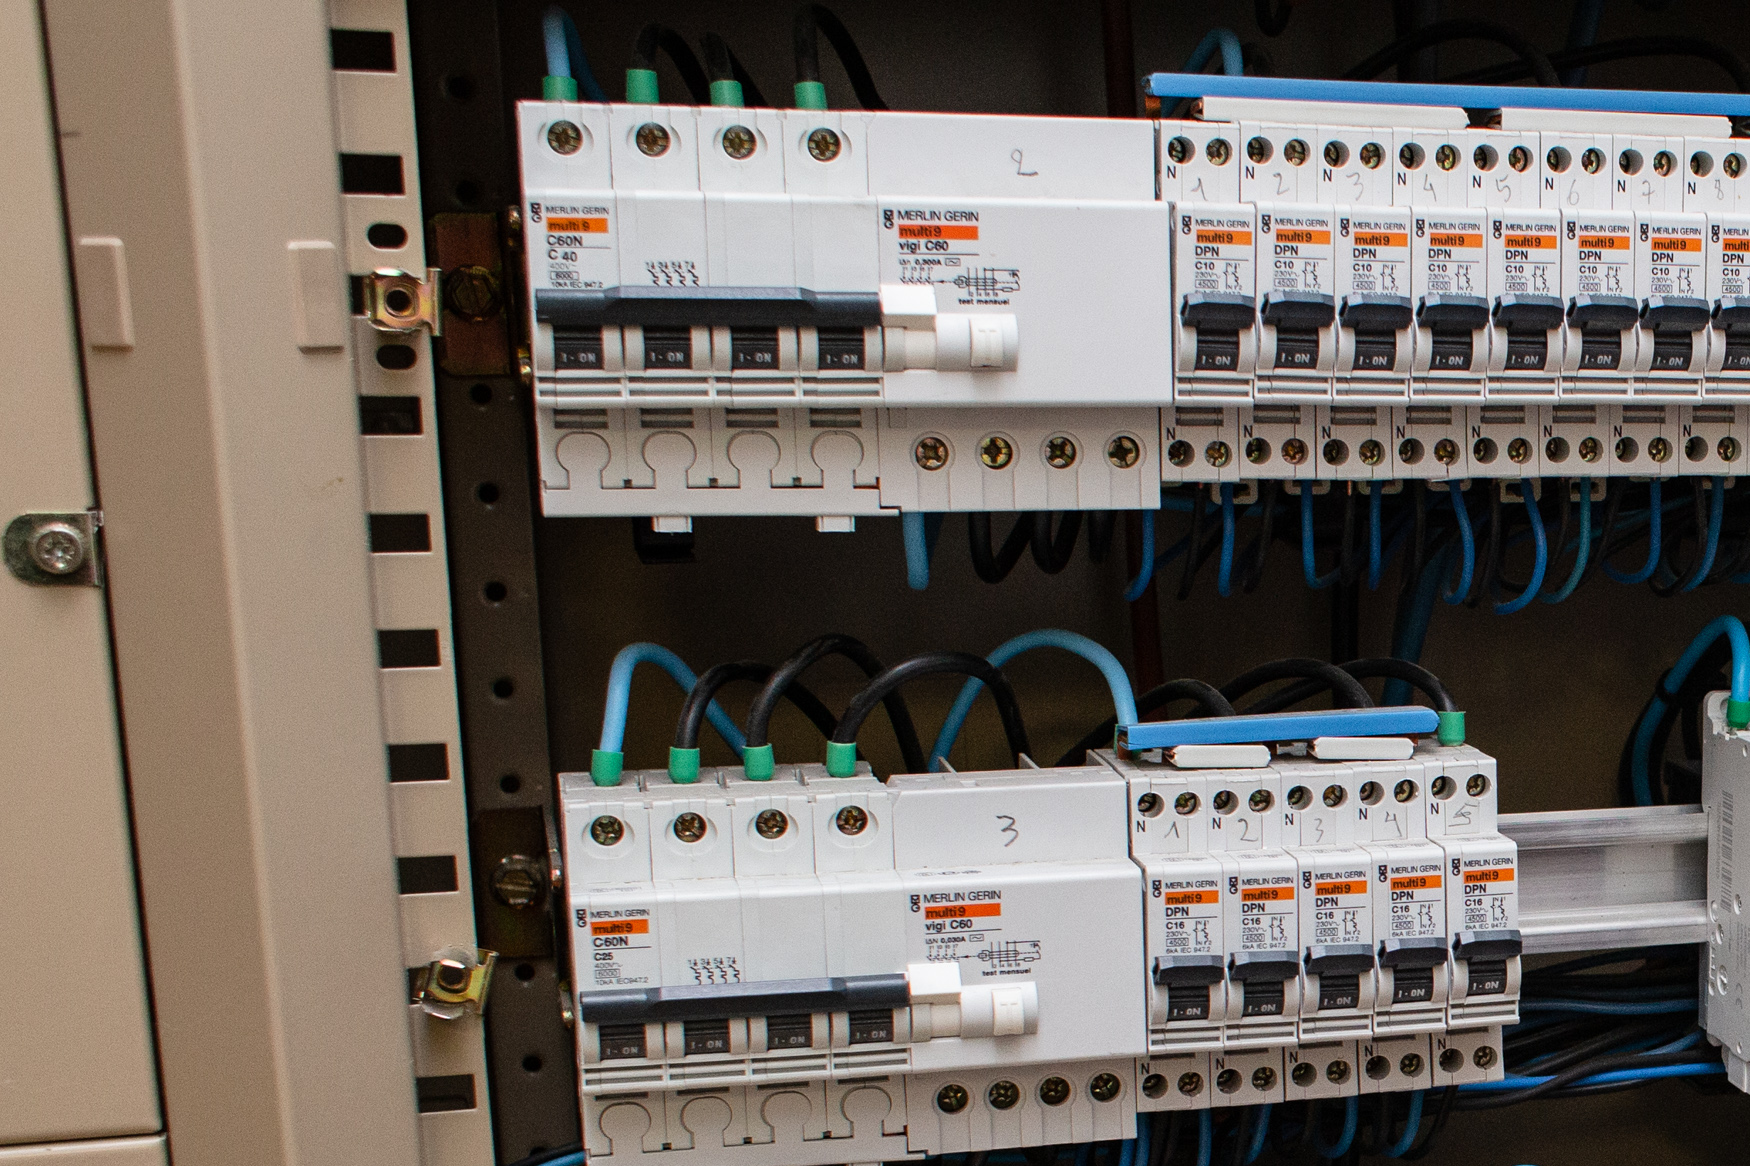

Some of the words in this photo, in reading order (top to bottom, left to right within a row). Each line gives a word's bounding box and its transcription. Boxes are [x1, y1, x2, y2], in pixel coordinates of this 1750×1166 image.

[546, 206, 580, 215] MERLIN
[582, 207, 609, 215] GERIN
[898, 211, 941, 222] MERLIN
[944, 211, 979, 222] GERIN
[1195, 218, 1225, 228] MERLIN
[1226, 219, 1250, 229] GERIN
[547, 235, 583, 247] C60N
[899, 240, 921, 253] vigi
[925, 240, 949, 251] C60
[562, 251, 578, 262] 40
[1195, 245, 1219, 257] DPN
[1352, 248, 1376, 259] DPN
[1195, 261, 1215, 270] C10
[1164, 821, 1180, 838] 1
[1385, 811, 1403, 837] 4
[996, 815, 1019, 847] 3
[1237, 818, 1259, 842] 2
[1314, 818, 1324, 843] 3
[1464, 859, 1491, 868] MERLIN
[1492, 857, 1513, 866] GERIN
[1165, 881, 1193, 890] MERLIN
[1194, 880, 1218, 888] GERIN
[1464, 884, 1487, 894] DPN
[924, 891, 965, 903] MERLIN
[968, 890, 1001, 901] GERIN
[1316, 897, 1339, 907] DPN
[1464, 898, 1483, 907] C16
[590, 910, 623, 919] MERLIN
[624, 908, 650, 917] GERIN
[1165, 907, 1189, 917] DPN
[1316, 911, 1335, 920] C16
[925, 920, 946, 933] vigi
[950, 919, 973, 930] C60
[1166, 921, 1185, 930] C16
[593, 936, 629, 948] C60N
[999, 968, 1031, 976] mensuel
